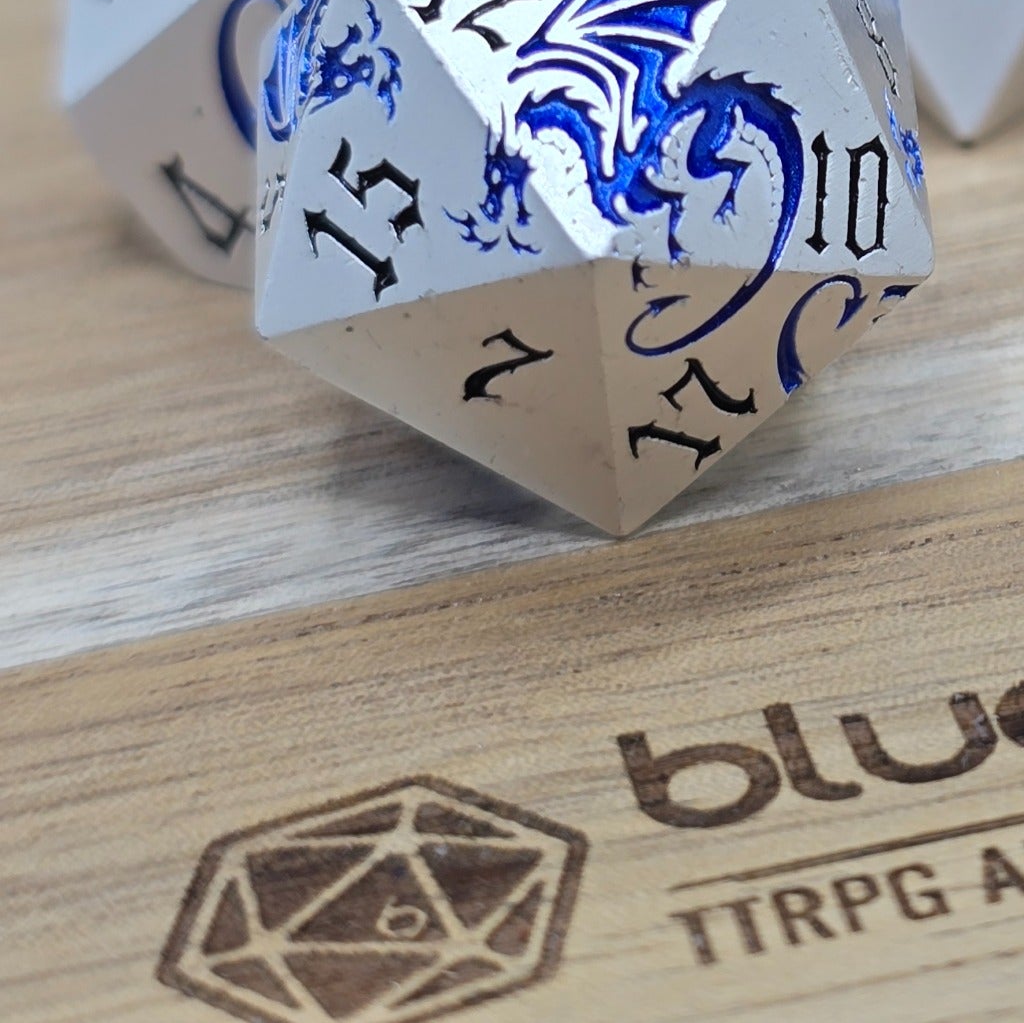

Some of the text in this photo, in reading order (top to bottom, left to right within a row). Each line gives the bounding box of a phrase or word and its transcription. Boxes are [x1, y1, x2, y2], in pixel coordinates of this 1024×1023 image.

[303, 136, 425, 303] 15
[804, 129, 890, 261] 10
[668, 862, 951, 966] TTRPG
